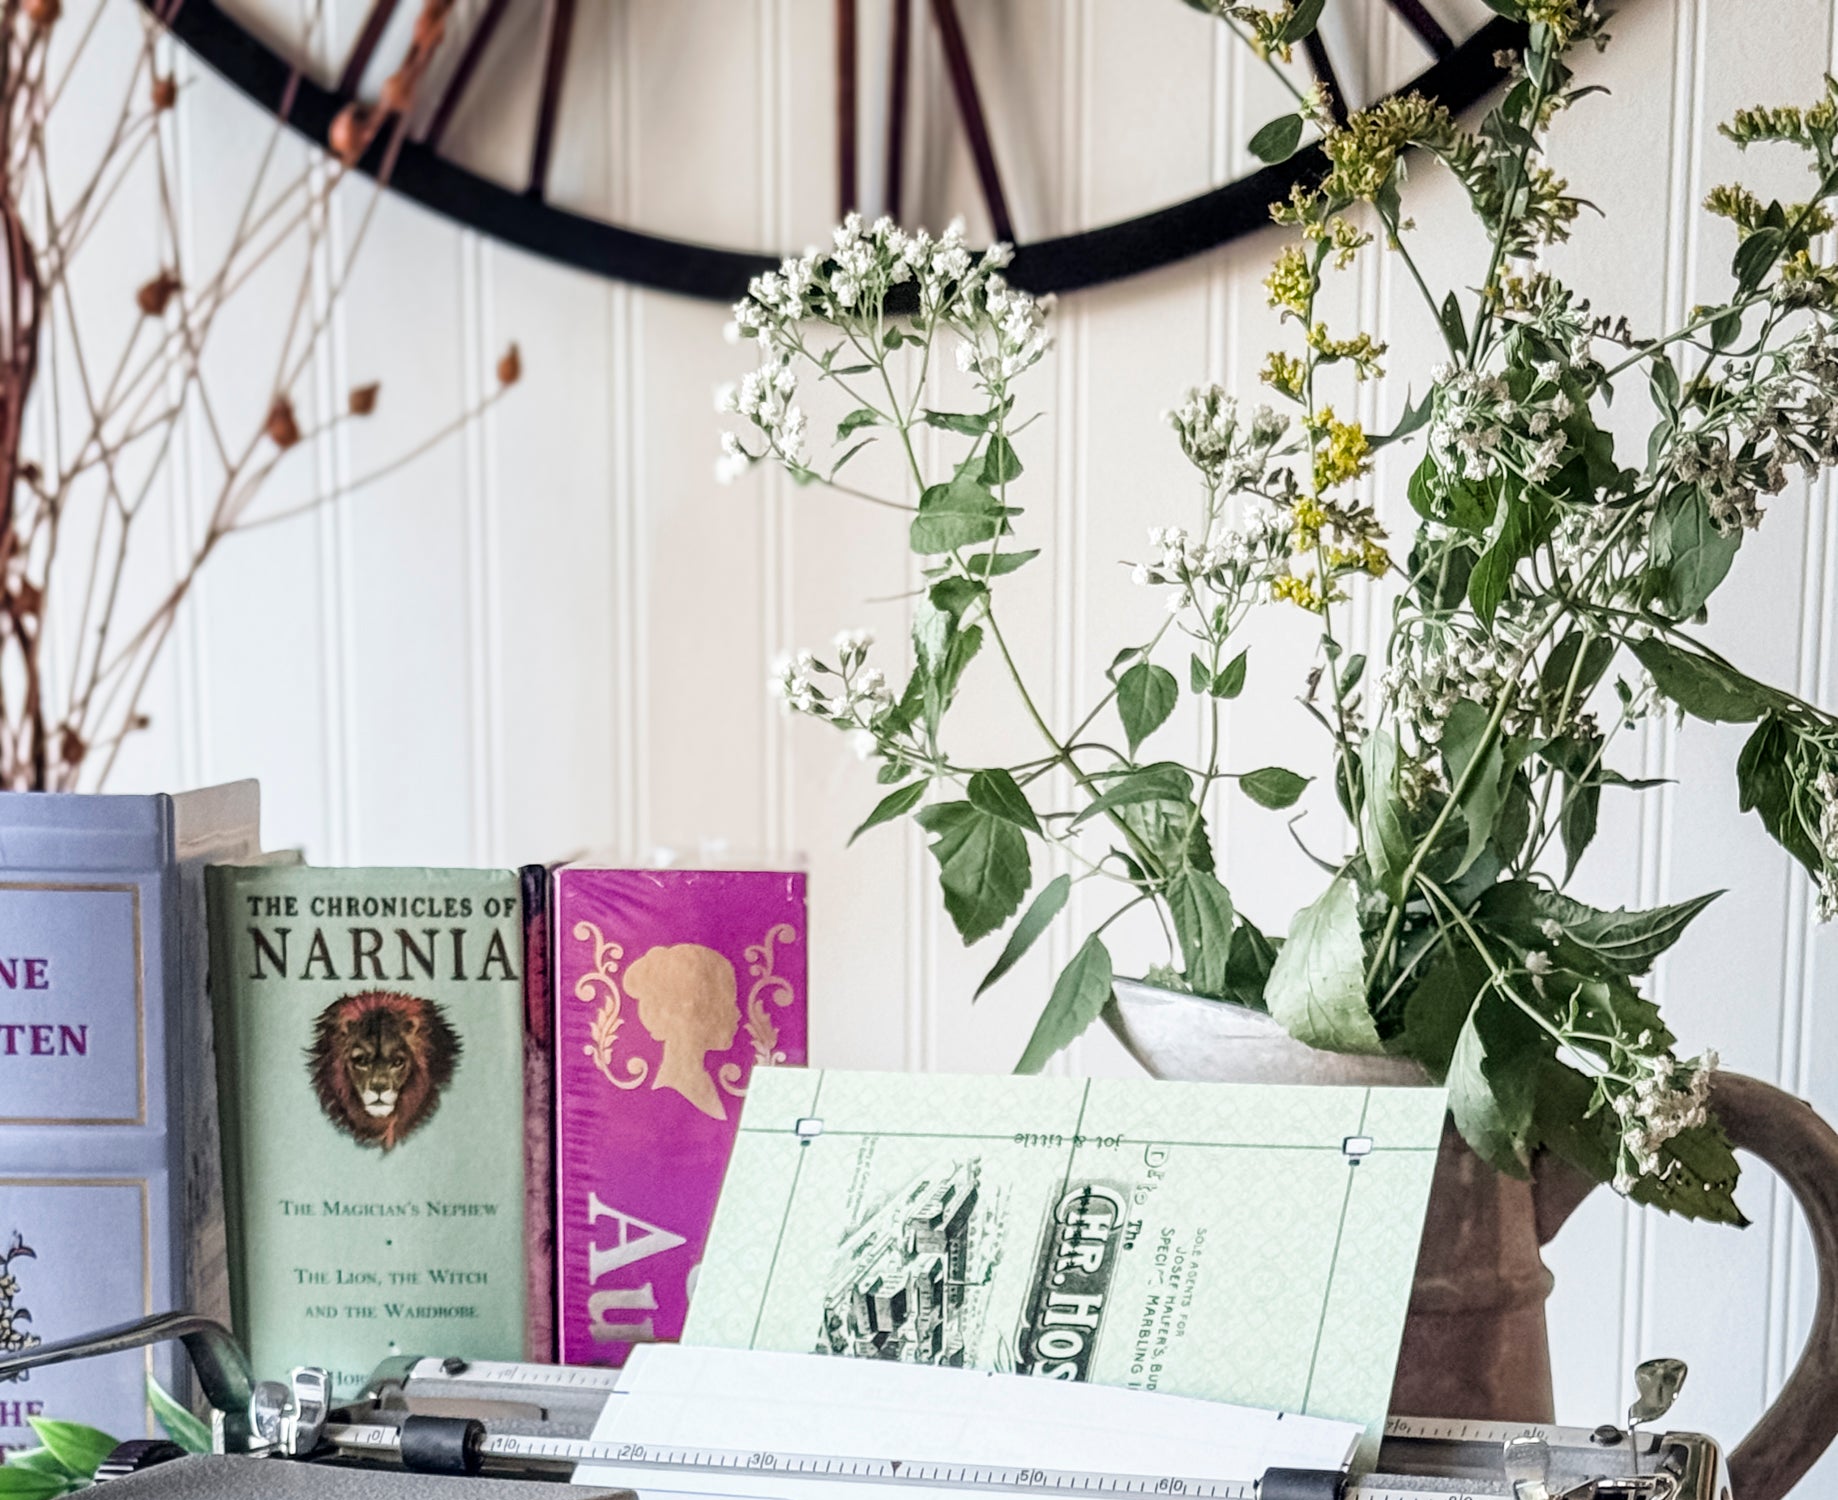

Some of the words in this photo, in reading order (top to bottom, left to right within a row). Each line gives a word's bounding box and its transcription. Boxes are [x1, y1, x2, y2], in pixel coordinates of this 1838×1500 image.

[247, 896, 299, 917] THE
[310, 896, 473, 918] CHRONICLES
[484, 897, 517, 918] OF
[247, 926, 519, 981] NARNIA
[0, 1024, 88, 1056] TEN
[322, 1200, 421, 1217] MAGICIAN'S
[427, 1201, 498, 1218] NEPHEW
[1121, 1219, 1144, 1252] The
[428, 1269, 489, 1285] WITCH
[1167, 1246, 1185, 1290] JOSEF
[305, 1305, 338, 1319] AND
[346, 1305, 377, 1319] THE
[384, 1303, 479, 1320] WARDROBE
[1130, 1294, 1160, 1376] MARBLING
[1174, 1313, 1189, 1339] FOR
[621, 1445, 645, 1458] 20
[751, 1453, 774, 1466] 30
[1020, 1469, 1044, 1483] 50
[1159, 1478, 1183, 1492] 60
